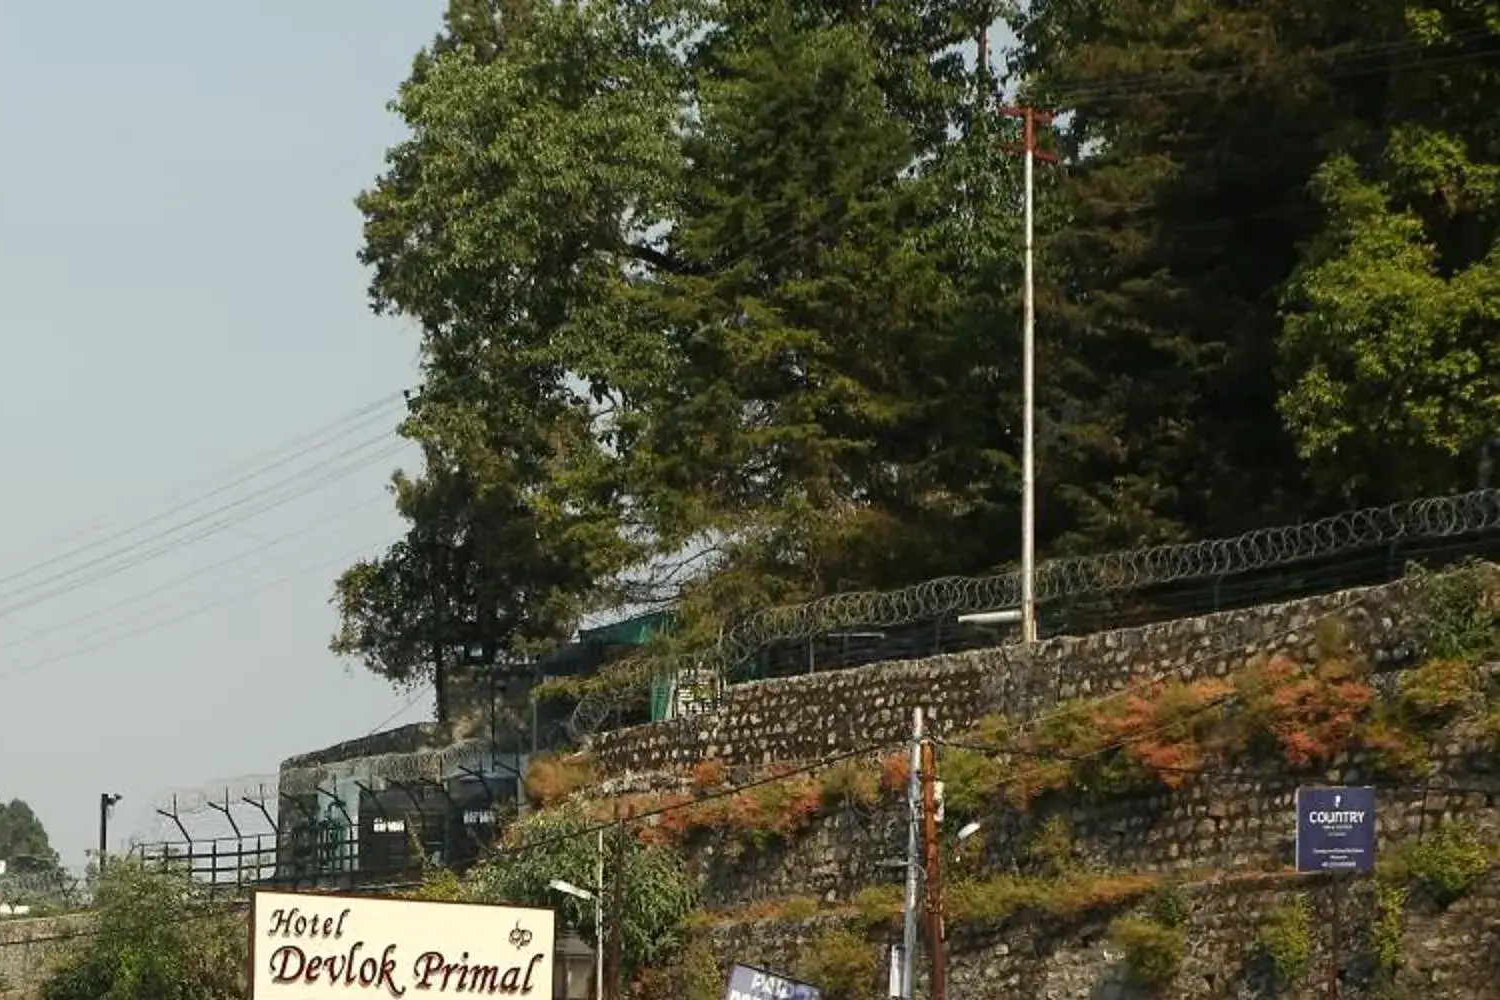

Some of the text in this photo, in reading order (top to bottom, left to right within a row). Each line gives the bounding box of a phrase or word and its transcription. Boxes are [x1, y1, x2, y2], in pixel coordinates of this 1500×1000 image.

[1309, 811, 1365, 824] COUNTRY
[267, 907, 351, 939] Hotel
[269, 941, 544, 999] Devlok Primal
